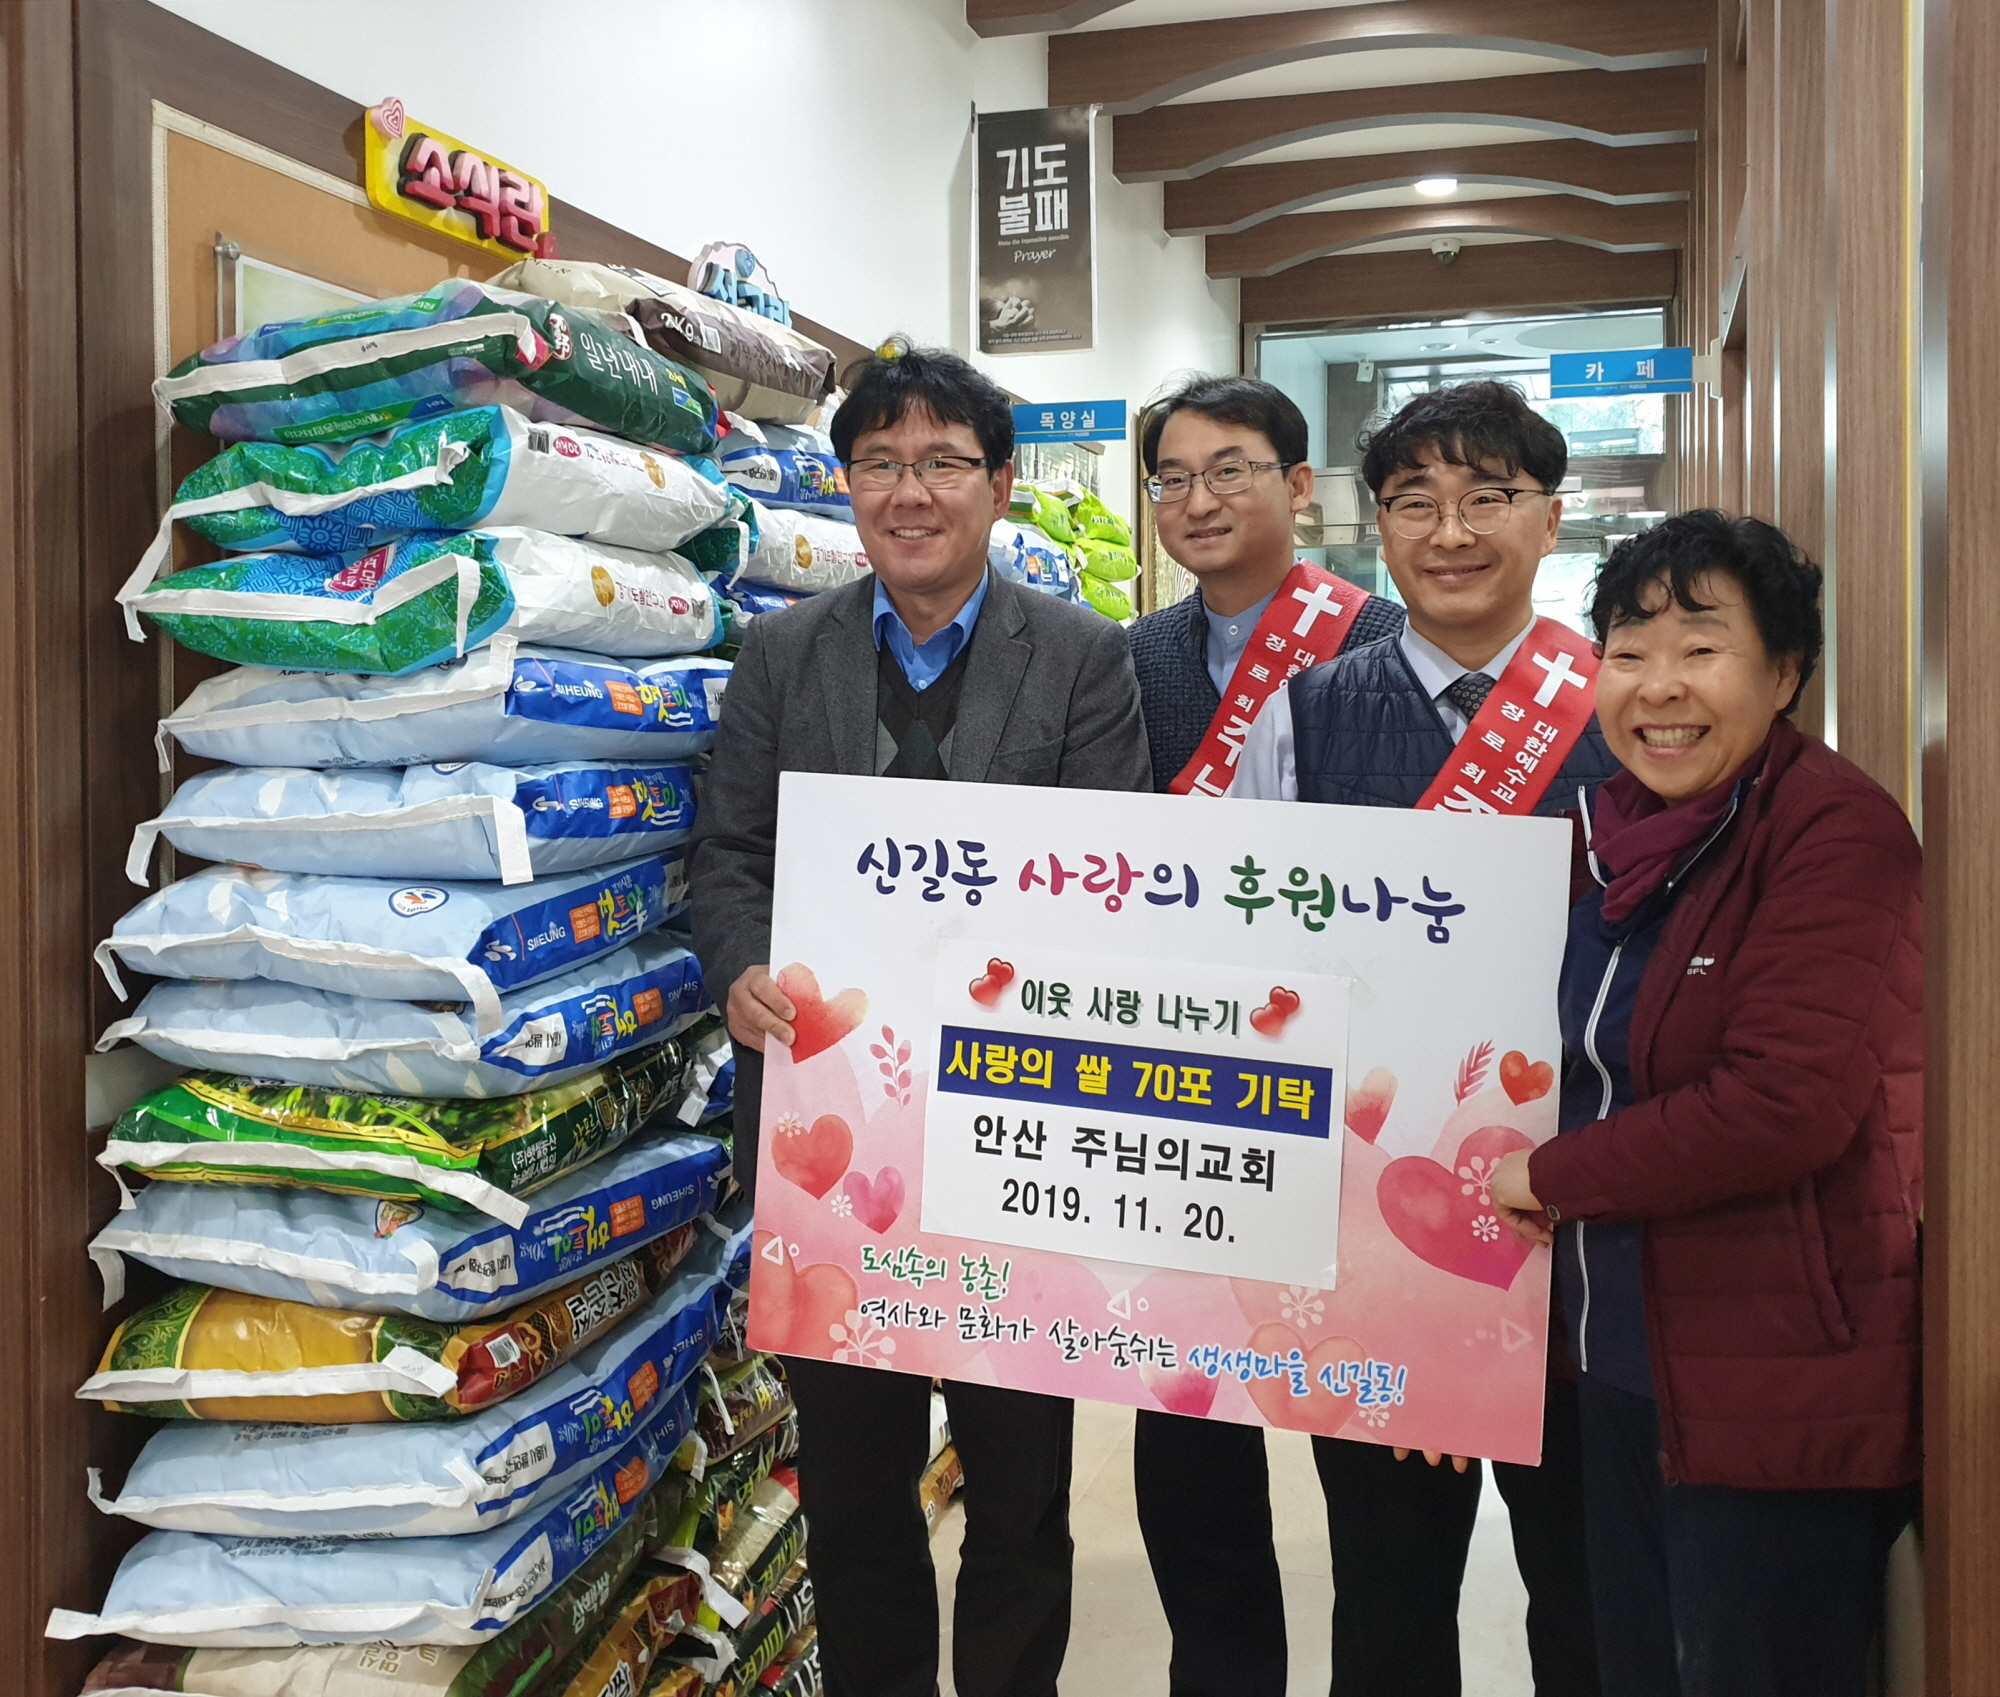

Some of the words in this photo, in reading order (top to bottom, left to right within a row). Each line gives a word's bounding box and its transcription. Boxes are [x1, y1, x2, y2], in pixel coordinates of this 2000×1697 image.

[405, 137, 545, 252] 소식란
[996, 143, 1068, 190] 기도
[998, 188, 1069, 236] 불패
[1014, 247, 1056, 263] Prayer
[580, 332, 658, 396] 일년내내
[1585, 358, 1655, 381] 카페
[1040, 409, 1096, 430] 목양실
[555, 681, 604, 699] SIHEUNG
[1490, 720, 1559, 806] 대한예수교
[856, 837, 998, 907] 신길동
[1018, 852, 1200, 913] 사랑의
[1224, 854, 1466, 944] 후원나눔
[1021, 977, 1072, 1019] 이웃
[1087, 985, 1142, 1026] 사랑
[1157, 992, 1242, 1036] 나누기
[946, 1039, 1054, 1089] 사랑의
[1074, 1053, 1112, 1096] 쌀
[1131, 1061, 1214, 1106] 70포
[1236, 1071, 1316, 1121] 기탁
[973, 1114, 1048, 1162] 안산
[1071, 1126, 1276, 1193] 주님의교회
[651, 1184, 696, 1210] SIHEUNG
[1001, 1178, 1092, 1225] 2019.
[1113, 1193, 1162, 1234] 11.
[1183, 1203, 1236, 1244] 20.
[862, 1245, 946, 1288] 도심속의
[960, 1254, 1010, 1301] 농촌!
[860, 1298, 947, 1329] 역사와
[958, 1305, 1036, 1341] 문화가
[1048, 1317, 1177, 1368] 살아숨쉬는
[1188, 1345, 1309, 1396] 생생마을
[1318, 1360, 1407, 1405] 신길동!
